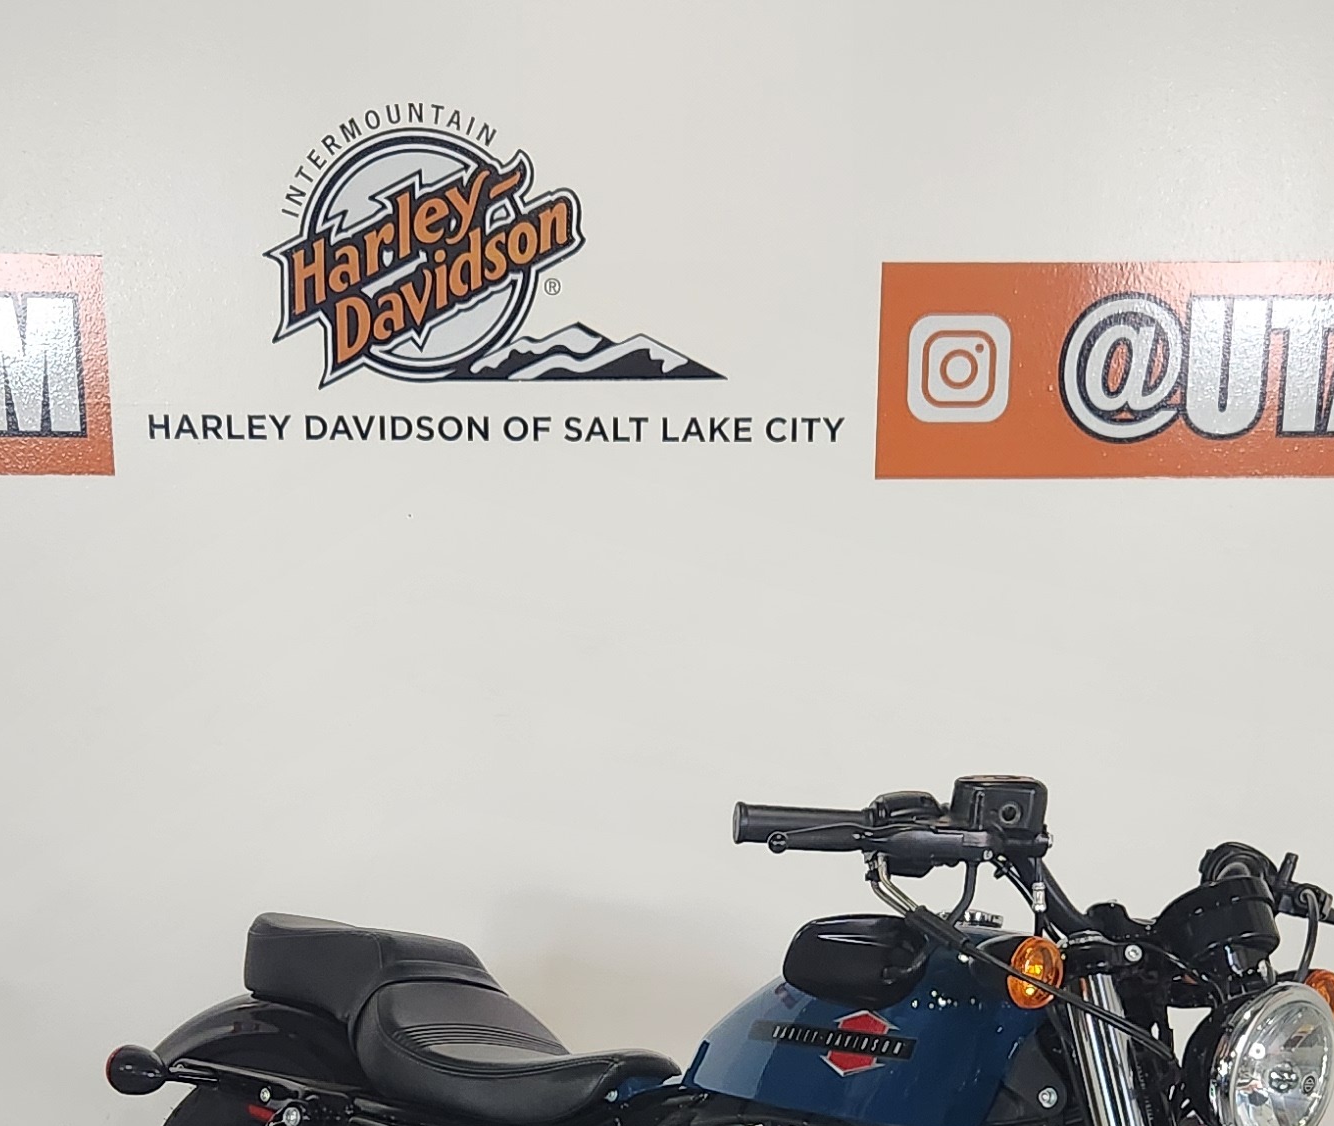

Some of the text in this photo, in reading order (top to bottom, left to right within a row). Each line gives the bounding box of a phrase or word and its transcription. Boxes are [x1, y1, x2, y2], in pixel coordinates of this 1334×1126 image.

[281, 102, 498, 217] INTERMOUNTAIN
[333, 197, 570, 364] Davidson
[148, 414, 845, 443] HARLEY DAVIDSON OF SALT LAKE CITY
